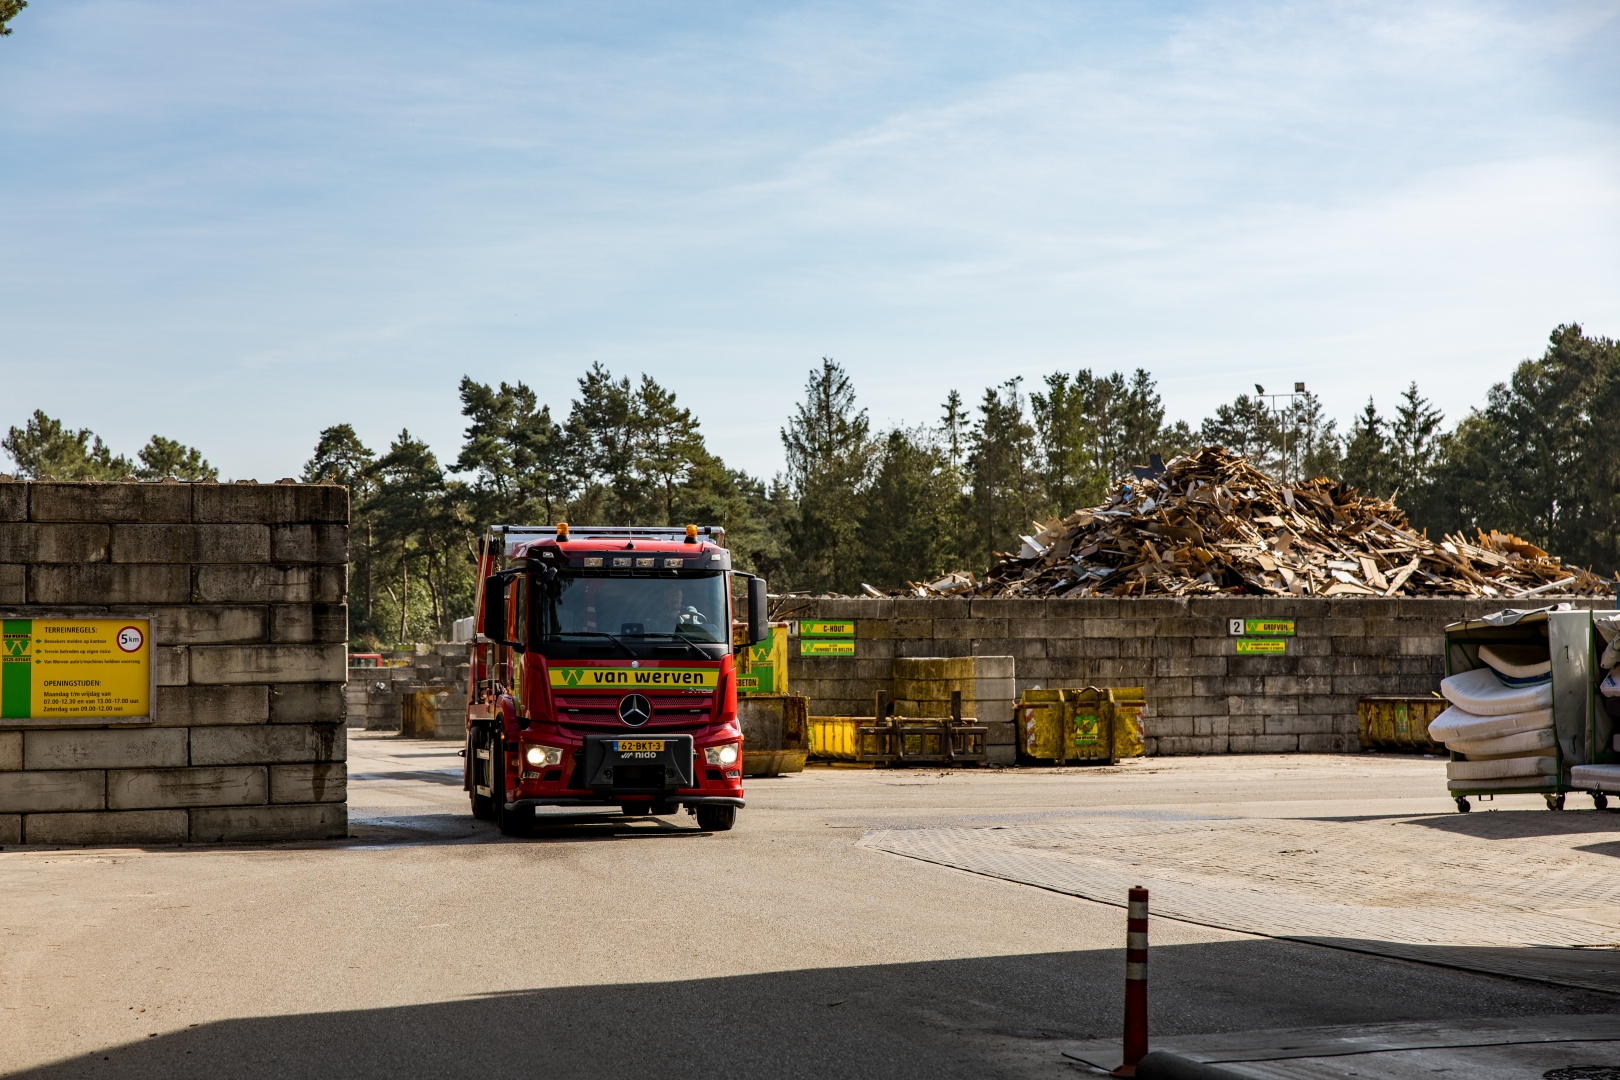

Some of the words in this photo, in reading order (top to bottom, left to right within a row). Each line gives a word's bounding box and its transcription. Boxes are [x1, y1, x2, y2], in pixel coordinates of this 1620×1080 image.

[789, 622, 793, 634] 1
[1234, 622, 1240, 632] 2
[121, 634, 128, 644] 5
[594, 670, 628, 684] van
[634, 671, 704, 684] werven
[621, 742, 661, 750] 62-BKT-3
